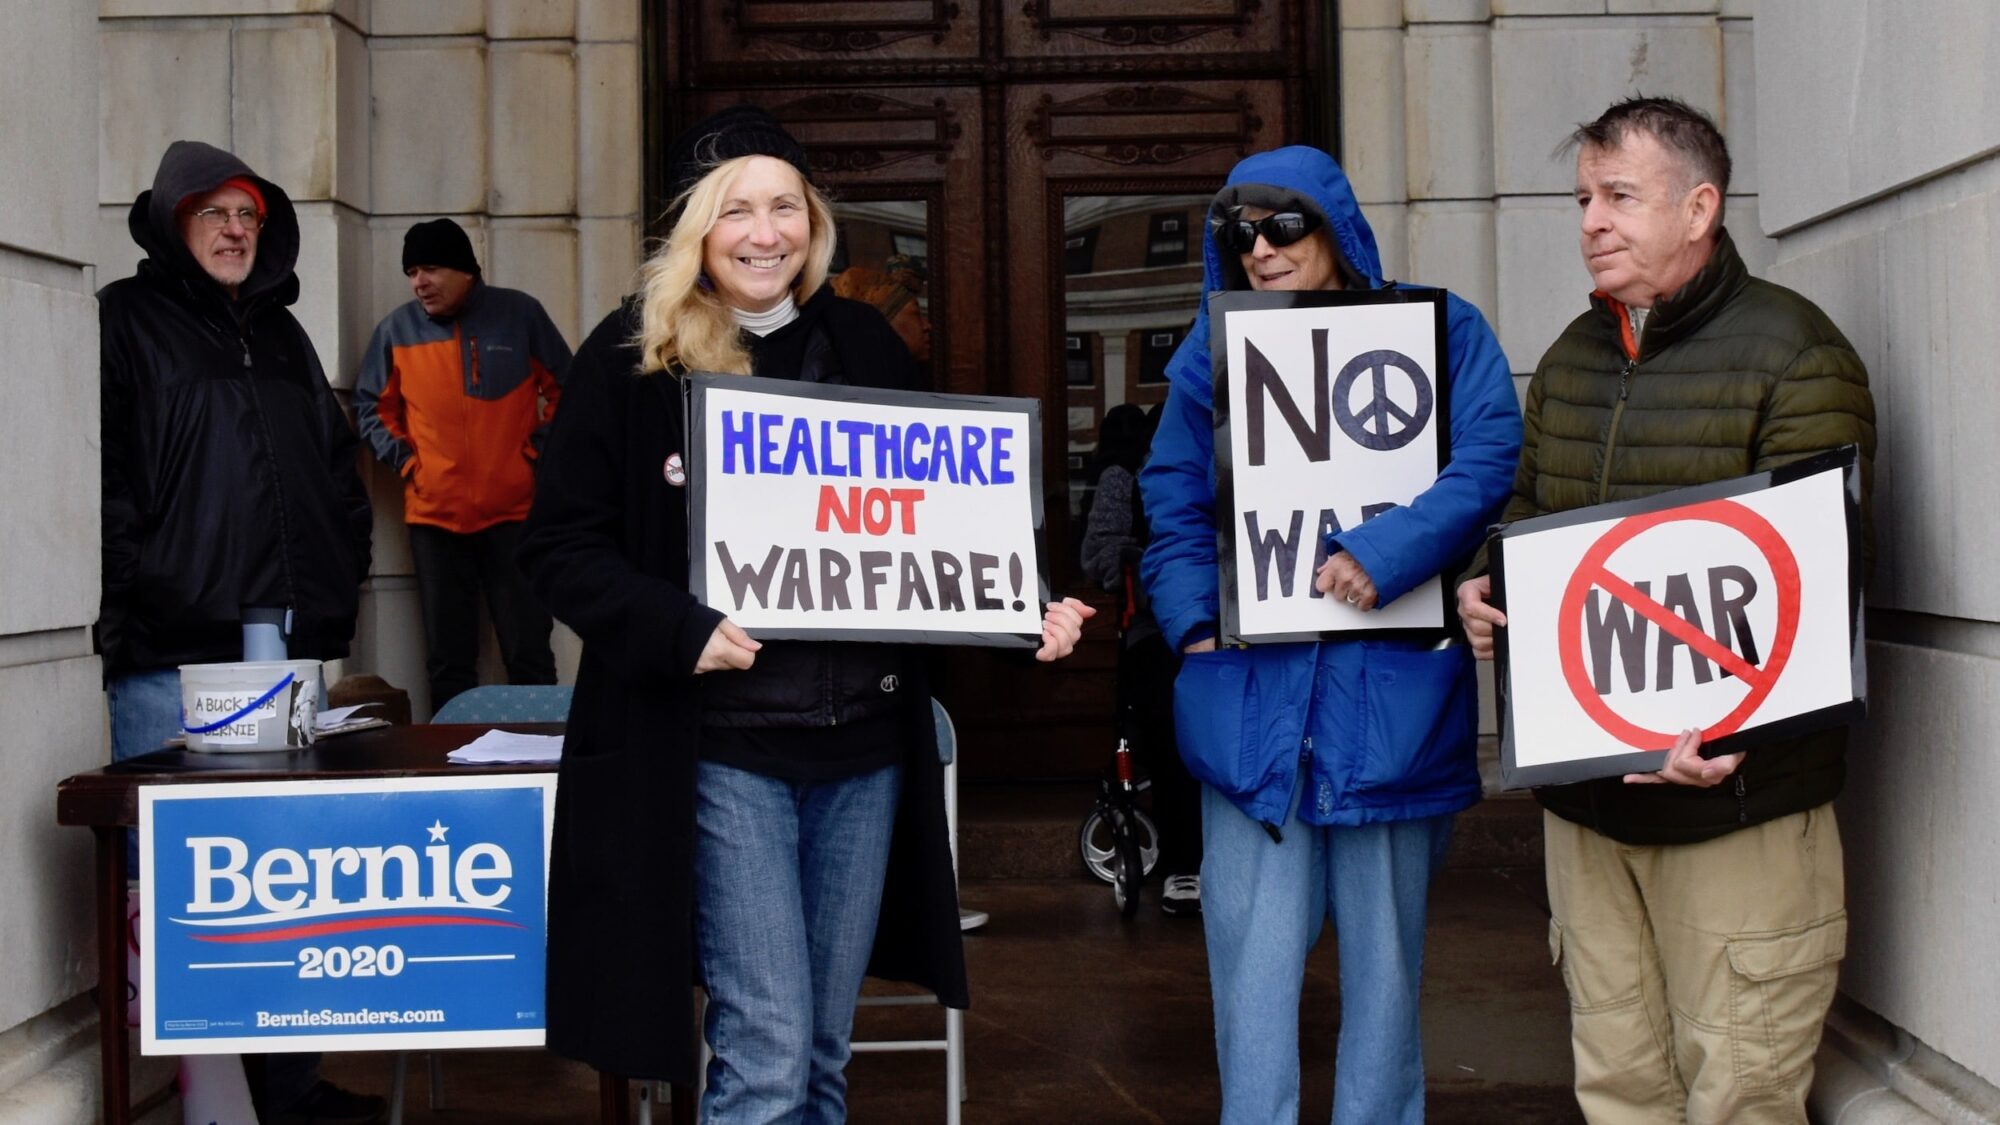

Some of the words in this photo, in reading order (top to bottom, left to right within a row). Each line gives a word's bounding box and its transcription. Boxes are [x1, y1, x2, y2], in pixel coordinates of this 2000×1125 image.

[721, 410, 1015, 486] HEALTHCARE
[815, 484, 926, 536] NOT
[714, 540, 1026, 613] WARFARE!
[1584, 565, 1760, 695] WAR
[195, 697, 204, 711] A
[206, 696, 243, 712] BUCK
[186, 822, 513, 914] Bernie
[298, 944, 405, 979] 2020
[256, 1008, 445, 1028] BernieSanders.com
